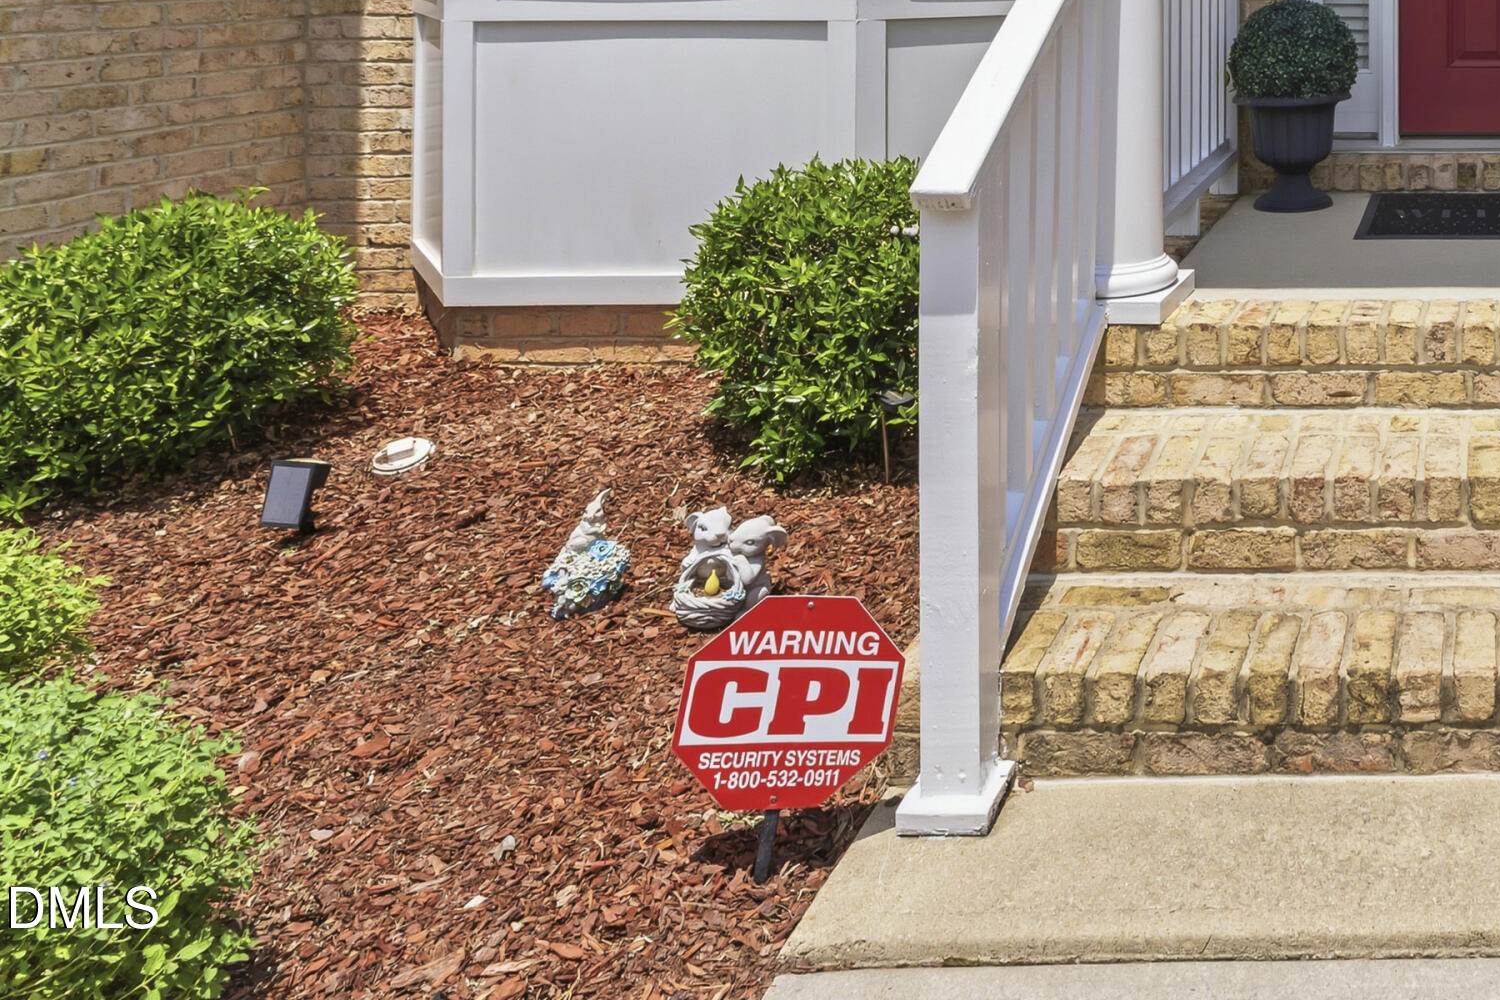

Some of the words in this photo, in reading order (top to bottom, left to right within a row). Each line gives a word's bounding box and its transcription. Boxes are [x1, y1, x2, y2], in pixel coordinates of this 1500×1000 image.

[728, 630, 881, 656] WARNING
[688, 666, 894, 739] CPI
[698, 750, 784, 770] SECURITY
[784, 749, 861, 767] SYSTEMS
[713, 768, 840, 790] 1-800-532-0911
